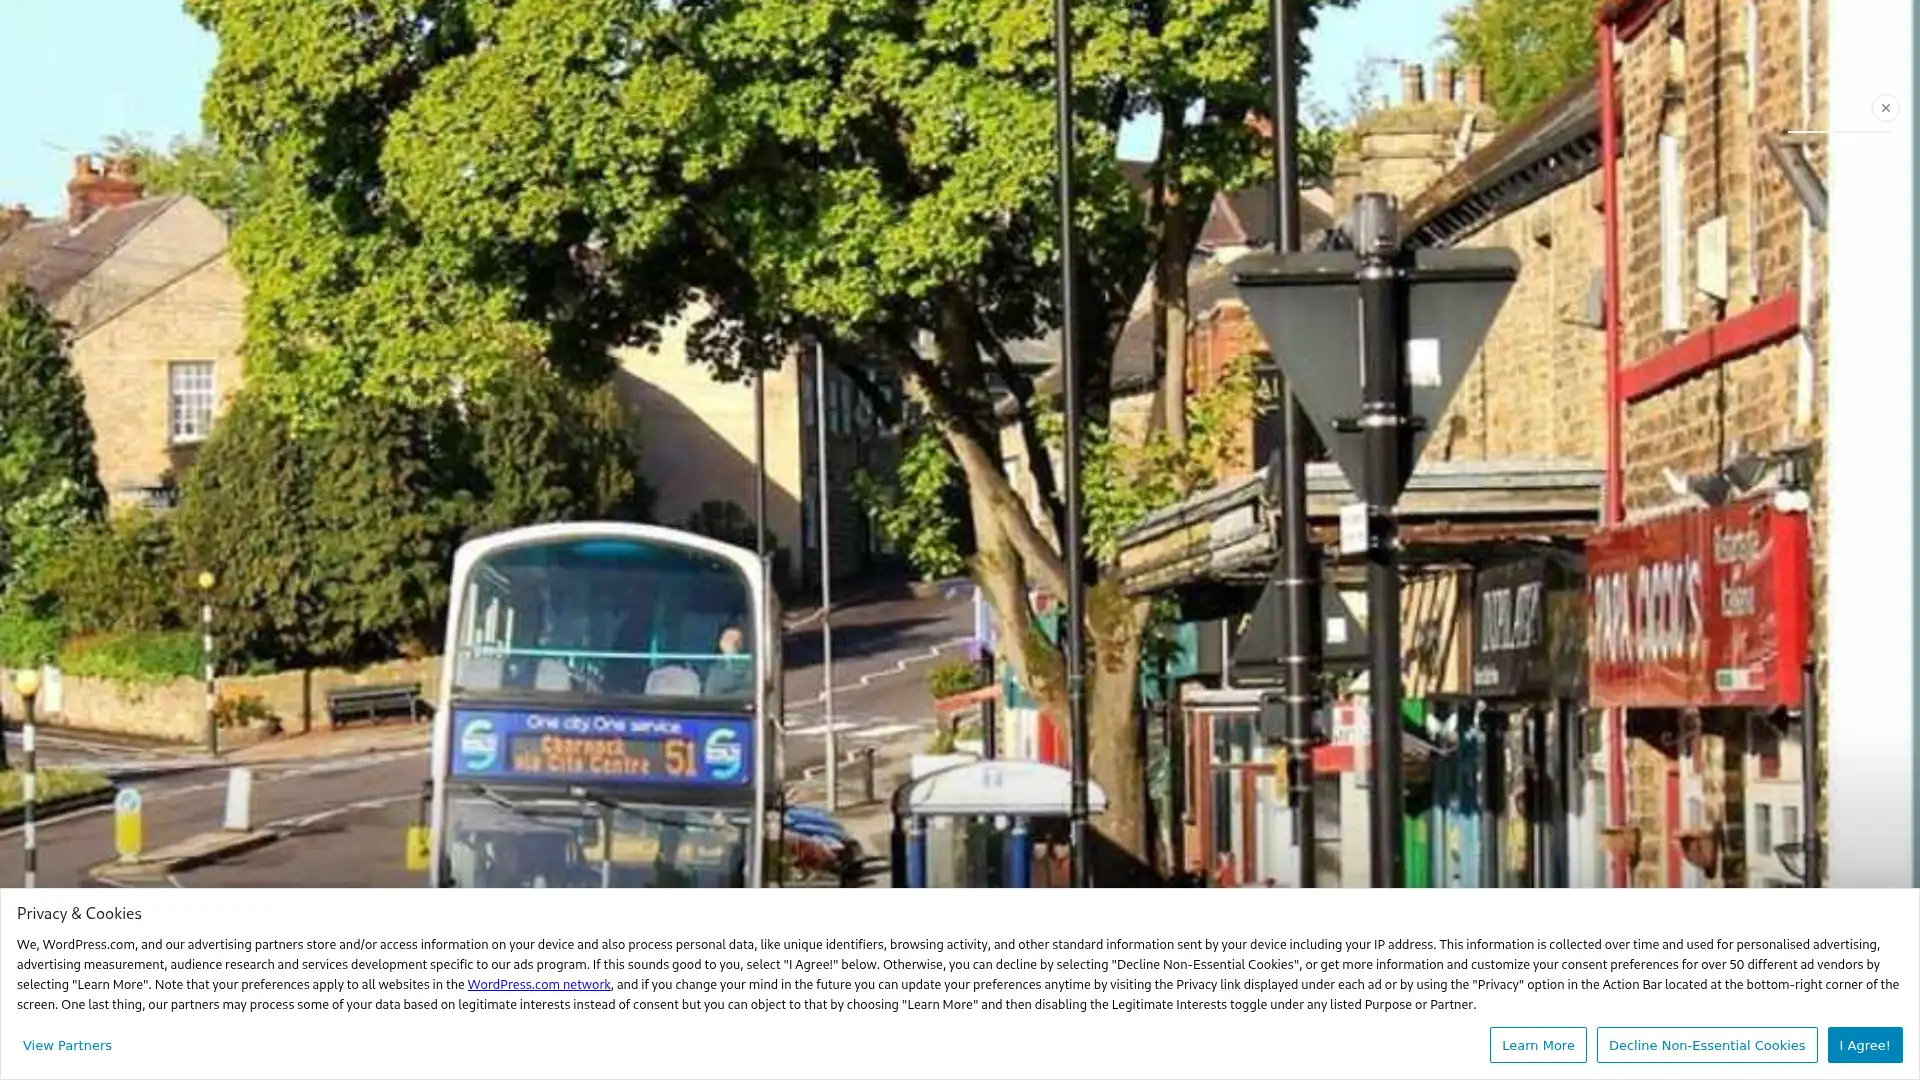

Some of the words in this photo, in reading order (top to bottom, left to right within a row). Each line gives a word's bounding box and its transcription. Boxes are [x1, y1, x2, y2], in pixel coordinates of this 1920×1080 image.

[526, 714, 559, 730] One
[592, 716, 625, 732] One
[664, 737, 697, 776] 51
